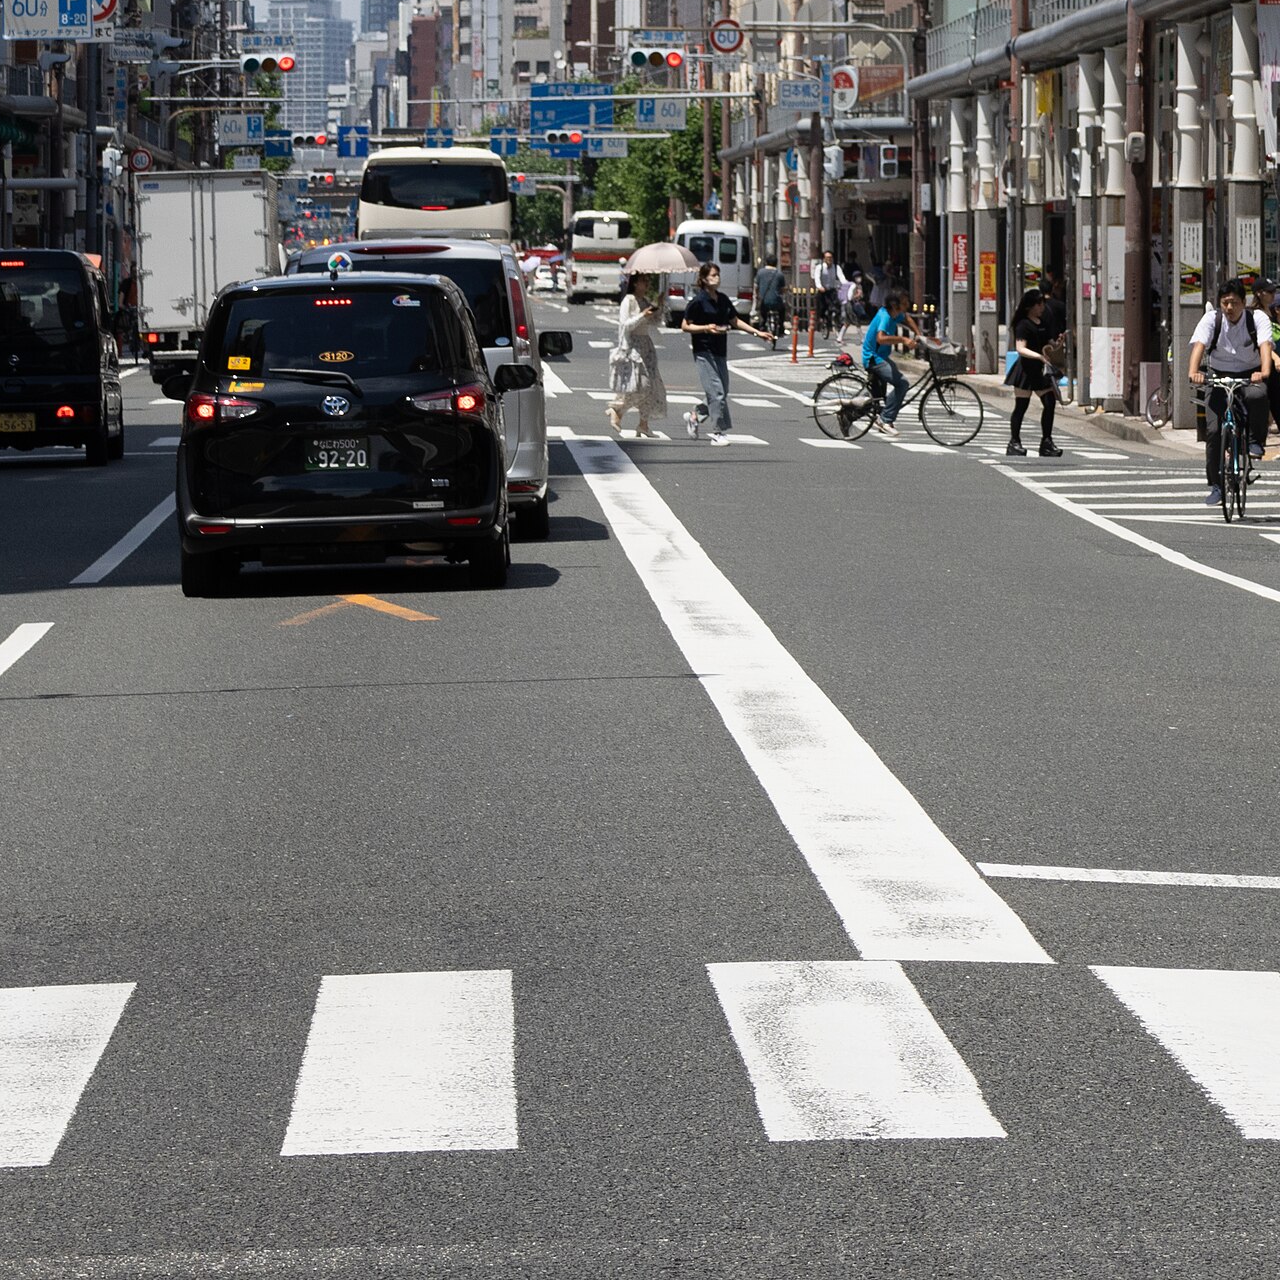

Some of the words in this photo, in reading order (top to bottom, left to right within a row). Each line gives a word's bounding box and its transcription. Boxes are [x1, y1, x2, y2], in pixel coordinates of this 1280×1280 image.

[61, 13, 87, 25] 8-20
[7, 29, 89, 38] パーキング・チケット
[717, 28, 737, 44] 60
[643, 101, 653, 113] P
[251, 117, 260, 130] P
[135, 154, 148, 167] 60
[957, 235, 968, 273] Joshin
[323, 351, 348, 360] 3120
[2, 419, 34, 431] 56-53
[318, 450, 367, 468] 92-20
